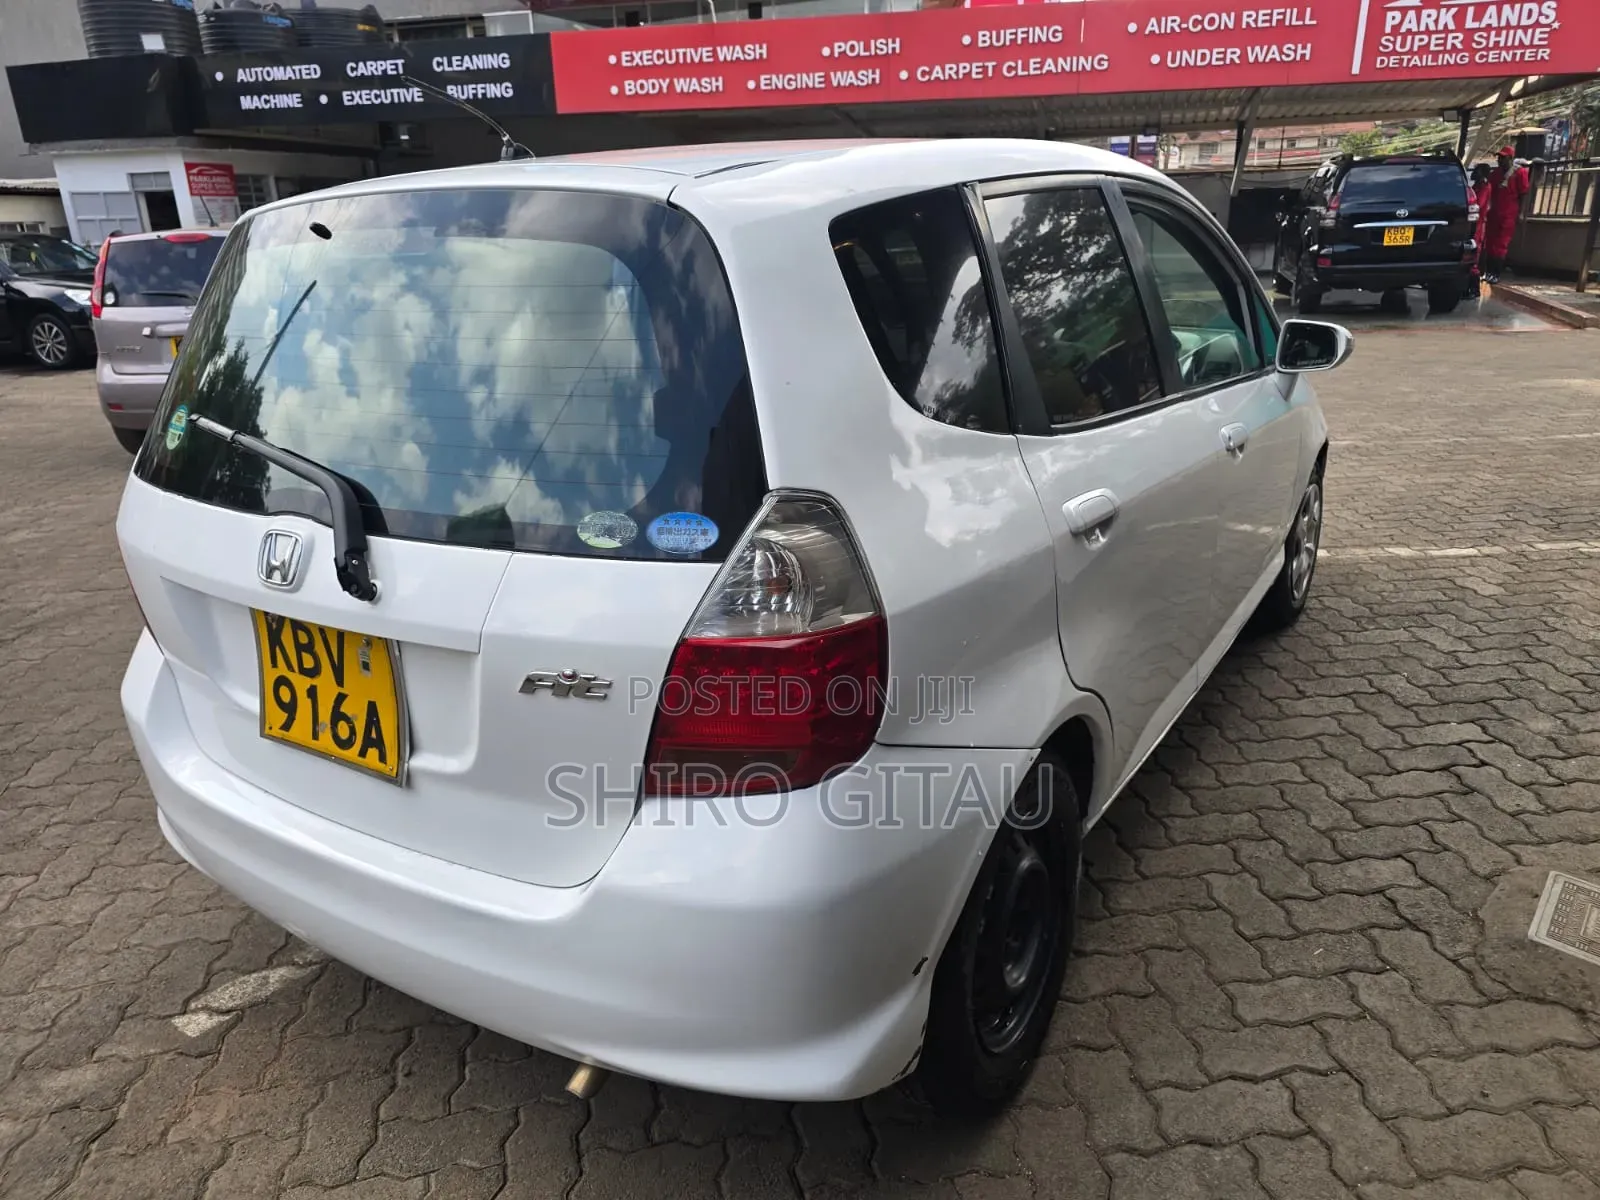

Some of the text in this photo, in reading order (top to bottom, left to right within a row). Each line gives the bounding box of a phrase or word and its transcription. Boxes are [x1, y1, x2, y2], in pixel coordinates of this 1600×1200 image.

[1144, 8, 1317, 35] AIR-CON REFILL
[1384, 2, 1557, 33] PARK LANDS
[833, 38, 900, 57] POLISH
[977, 26, 1063, 48] BUFFING
[1378, 28, 1551, 52] SUPER SHINE
[621, 44, 767, 67] EXECUTIVE WASH
[1166, 43, 1312, 68] UNDER WASH
[1376, 49, 1550, 69] DETAILING CENTER
[236, 53, 511, 83] AUTOMATED CARPET CLEANING
[760, 69, 881, 90] ENGINE WASH
[916, 54, 1109, 82] CARPET CLEANING
[342, 82, 514, 106] EXECUTIVE BUFFING
[624, 76, 724, 95] BODY WASH
[240, 93, 303, 110] MACHINE
[264, 611, 345, 688] KBV
[273, 675, 387, 765] 916A
